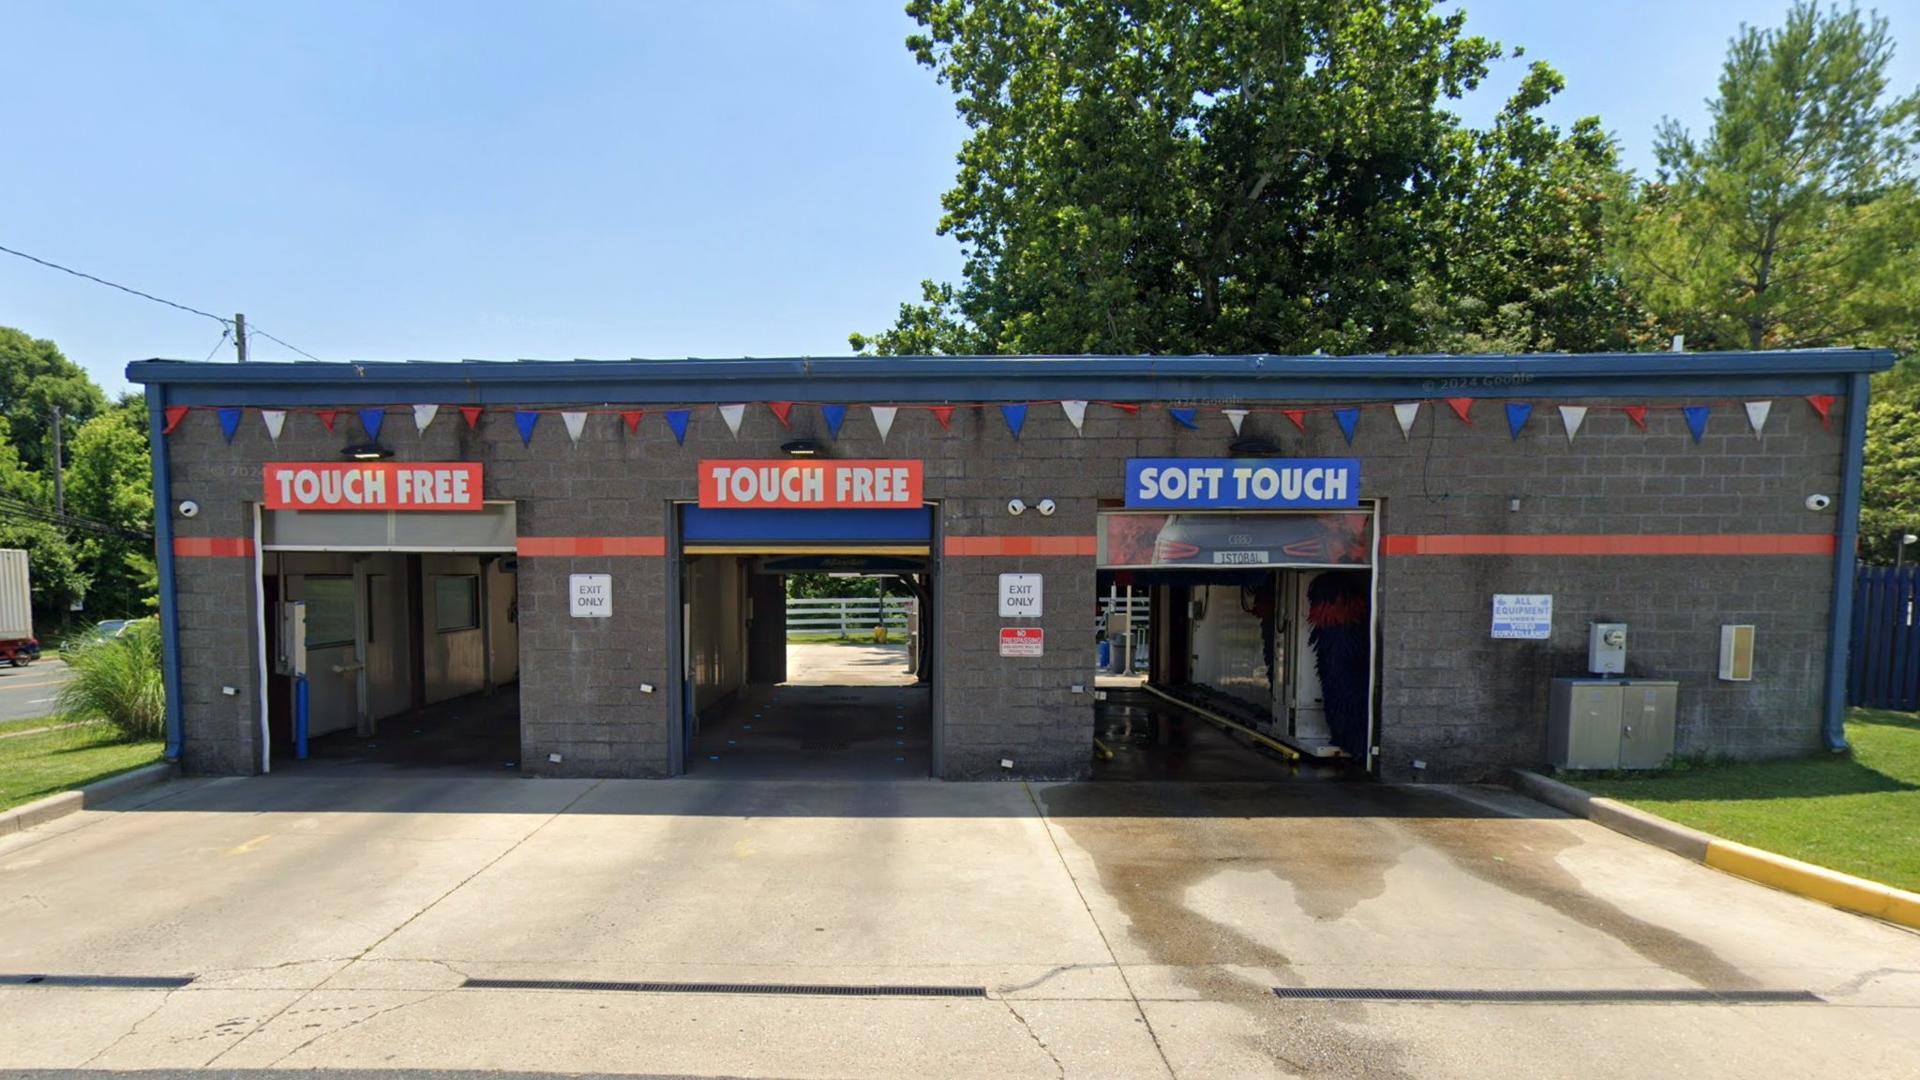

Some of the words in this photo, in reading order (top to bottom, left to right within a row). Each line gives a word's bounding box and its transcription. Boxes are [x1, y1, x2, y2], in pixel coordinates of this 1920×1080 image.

[275, 469, 386, 504] TOUCH
[397, 469, 471, 504] FREE
[712, 466, 824, 502] TOUCH
[836, 467, 910, 502] FREE
[1138, 467, 1224, 501] SOFT
[1233, 467, 1348, 500] TOUCH
[579, 585, 601, 595] EXIT
[1009, 585, 1032, 595] EXIT
[577, 597, 604, 607] ONLY
[1006, 597, 1034, 607] ONLY
[1514, 597, 1532, 605] ALL
[1495, 606, 1549, 615] EQUIPMENT
